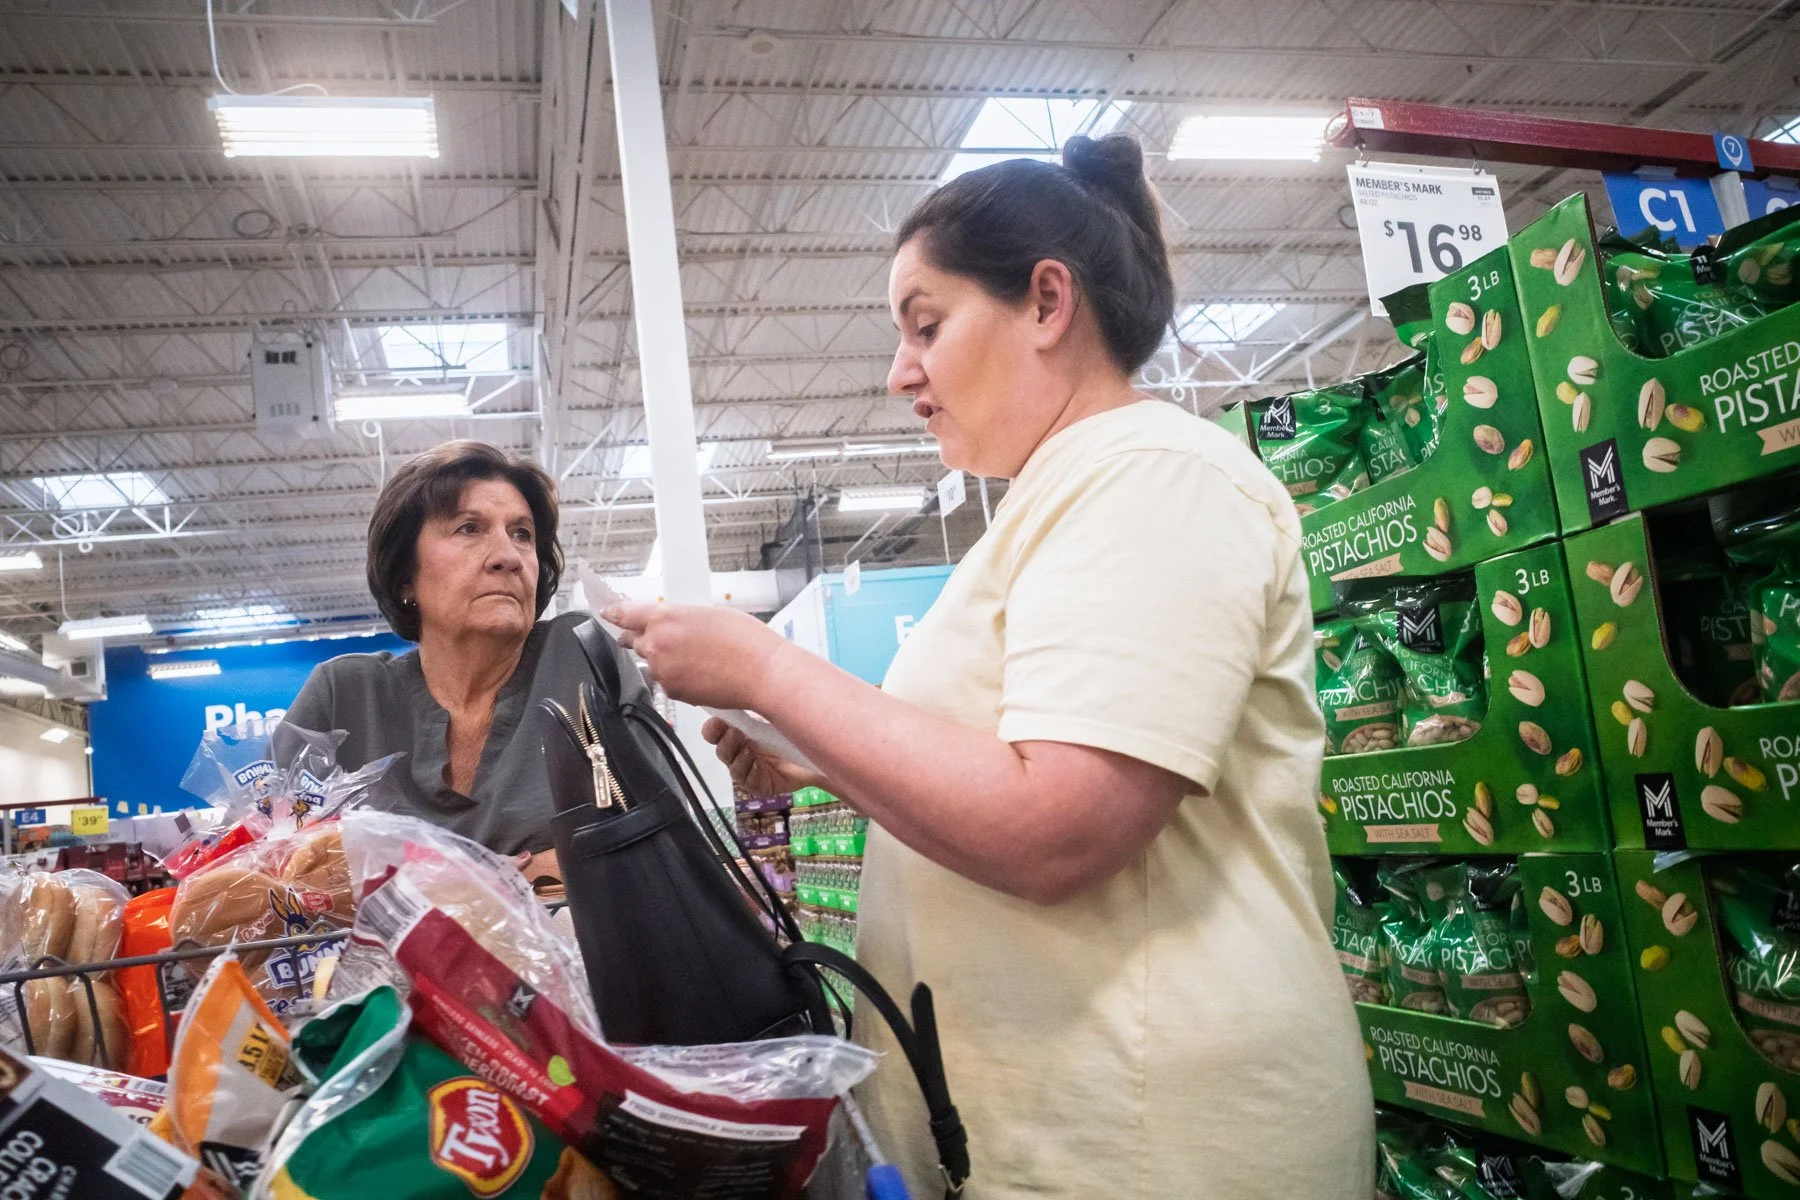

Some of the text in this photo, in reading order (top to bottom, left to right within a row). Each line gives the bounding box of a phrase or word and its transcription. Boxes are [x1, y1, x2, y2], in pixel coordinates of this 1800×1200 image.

[1727, 142, 1735, 153] 7
[1355, 177, 1443, 195] MEMBER'S MARK
[1358, 189, 1418, 201] SALTED PISTACHIOS
[1638, 187, 1697, 233] C1
[1467, 270, 1500, 302] 3 LB
[1699, 341, 1800, 397] ROASTED
[1266, 431, 1286, 439] Mark
[1590, 482, 1621, 499] Member's
[1598, 494, 1616, 506] Mark
[1301, 494, 1417, 550] ROASTED CALIFORNIA
[1309, 514, 1418, 577] PISTACHIOS
[1515, 568, 1550, 595] 3 LB
[1332, 769, 1455, 794] ROASTED CALIFORNIA
[1776, 763, 1800, 801] P
[21, 812, 39, 823] E4
[1340, 789, 1457, 821] PISTACHIOS
[1374, 828, 1430, 839] WITH SEA SALT
[1646, 818, 1678, 829] Member's
[1655, 827, 1673, 836] Mark
[1565, 870, 1602, 897] 3 LB
[1370, 1026, 1500, 1067] ROASTED CALIFORNIA
[1379, 1046, 1502, 1098] PISTACHIOS
[440, 1089, 510, 1169] Tyson
[1699, 1152, 1735, 1171] Member's
